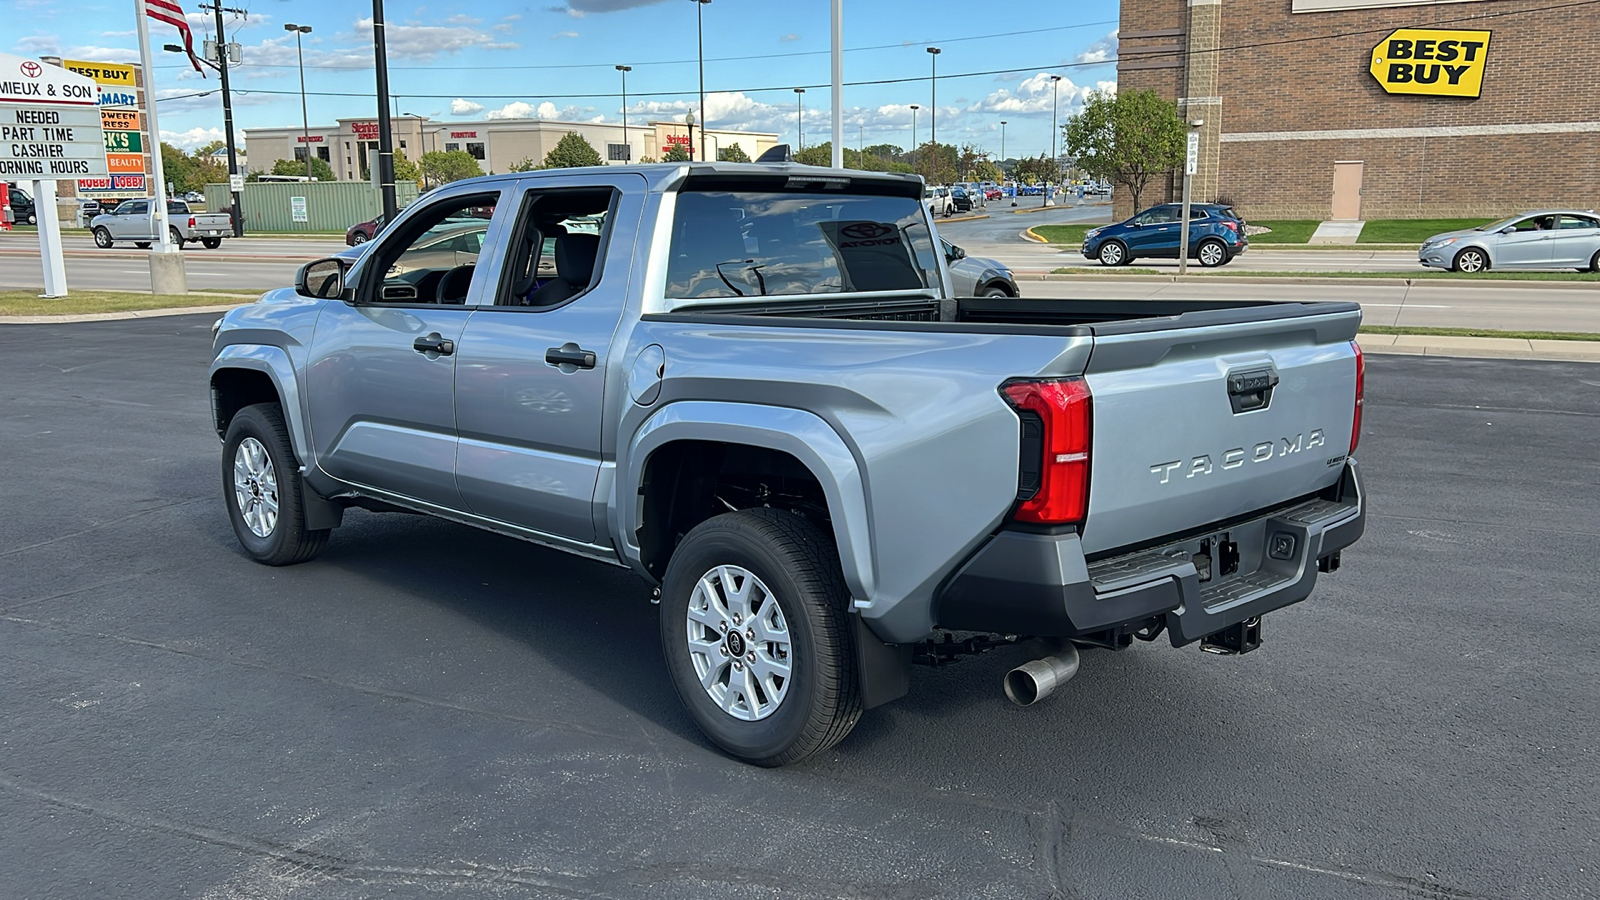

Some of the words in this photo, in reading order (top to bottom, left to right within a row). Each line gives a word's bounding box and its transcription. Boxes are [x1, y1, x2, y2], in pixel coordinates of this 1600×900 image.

[1387, 40, 1484, 62] BEST
[103, 70, 129, 80] BUY
[1387, 64, 1471, 85] BUY
[0, 82, 41, 96] MIEUX
[47, 84, 57, 96] &
[63, 85, 92, 98] SON
[16, 110, 59, 124] NEEDED
[2, 127, 34, 140] PART
[43, 128, 73, 141] TIME
[352, 122, 379, 133] Steinha
[12, 144, 64, 157] CASHIER
[50, 161, 88, 173] HOURS
[110, 158, 142, 167] BEAUTY
[79, 178, 110, 188] HOBBY
[114, 176, 144, 188] LOBBY
[1150, 428, 1325, 484] TACOMA
